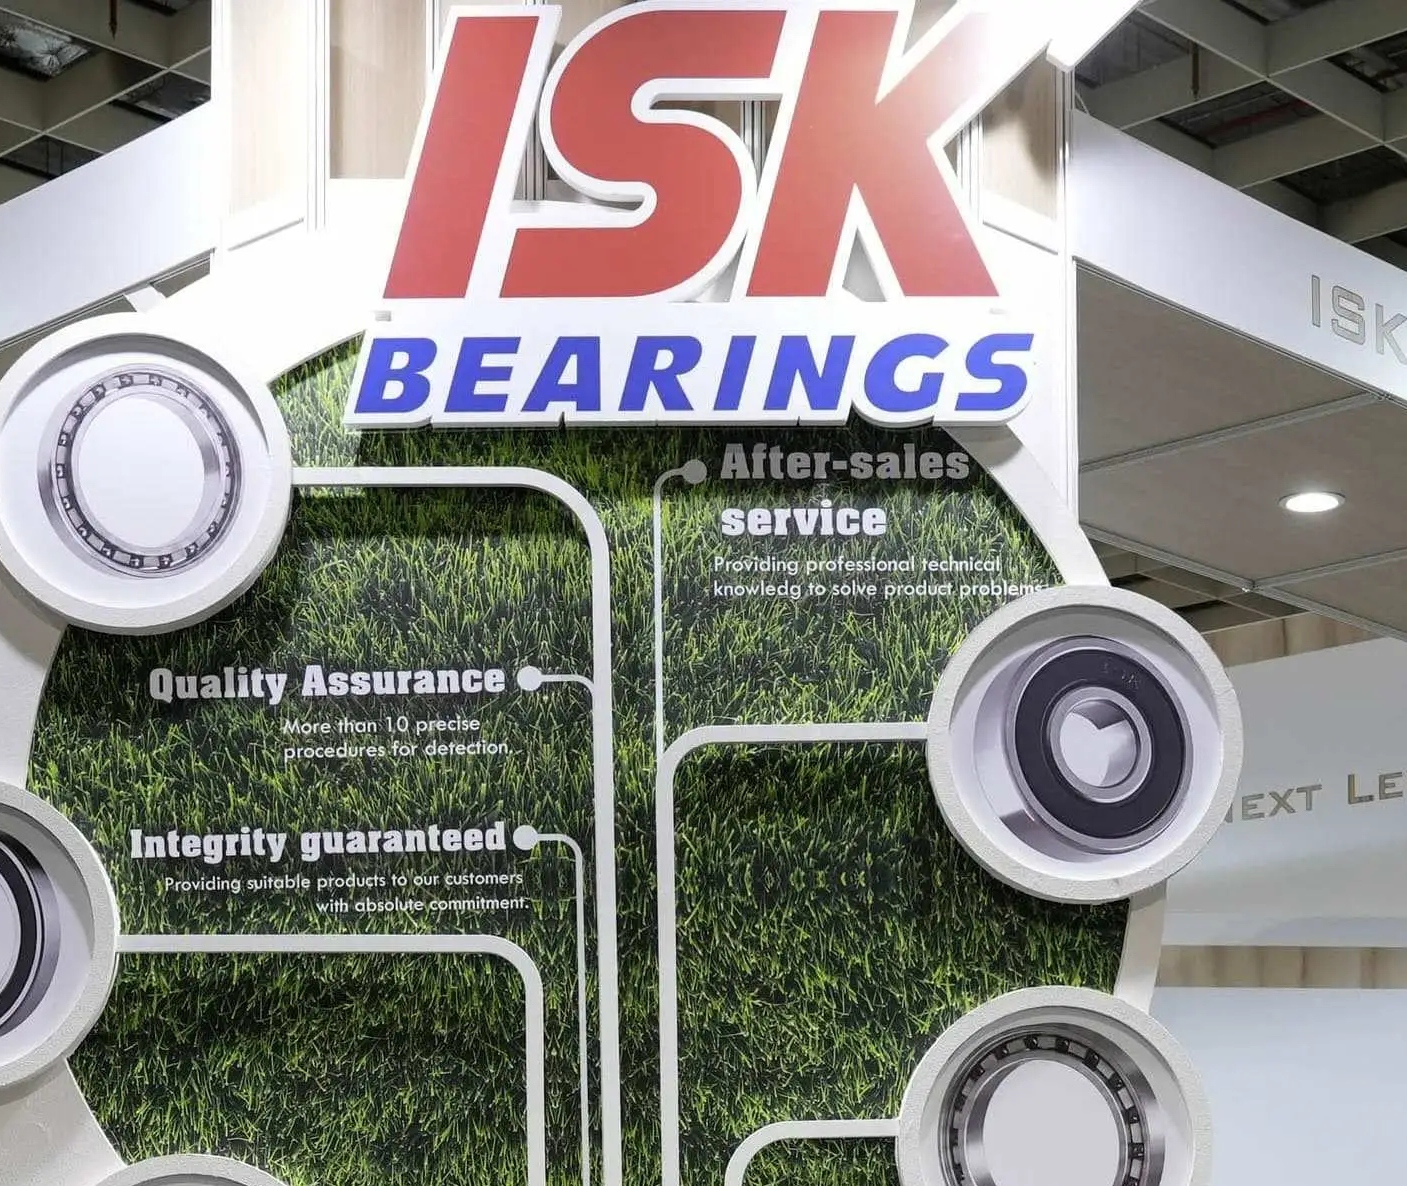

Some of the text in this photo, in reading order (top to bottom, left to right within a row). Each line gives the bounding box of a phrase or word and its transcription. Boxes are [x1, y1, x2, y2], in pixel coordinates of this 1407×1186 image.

[382, 9, 999, 299] ISK
[354, 333, 1034, 413] BEARINGS
[721, 443, 970, 480] After-sales
[721, 499, 887, 536] service
[714, 555, 1000, 576] Providing professional technical
[714, 580, 801, 600] knowledg
[808, 582, 826, 597] to
[832, 579, 877, 597] solve
[884, 579, 954, 600] product
[149, 665, 505, 705] Quality Assurance
[284, 715, 480, 736] More than 10 precise
[284, 738, 514, 763] procedures for detection.
[131, 821, 506, 864] Integrity guaranteed
[165, 871, 523, 894] Providing suitable products to our customers
[316, 895, 529, 914] with absolute commitment.
